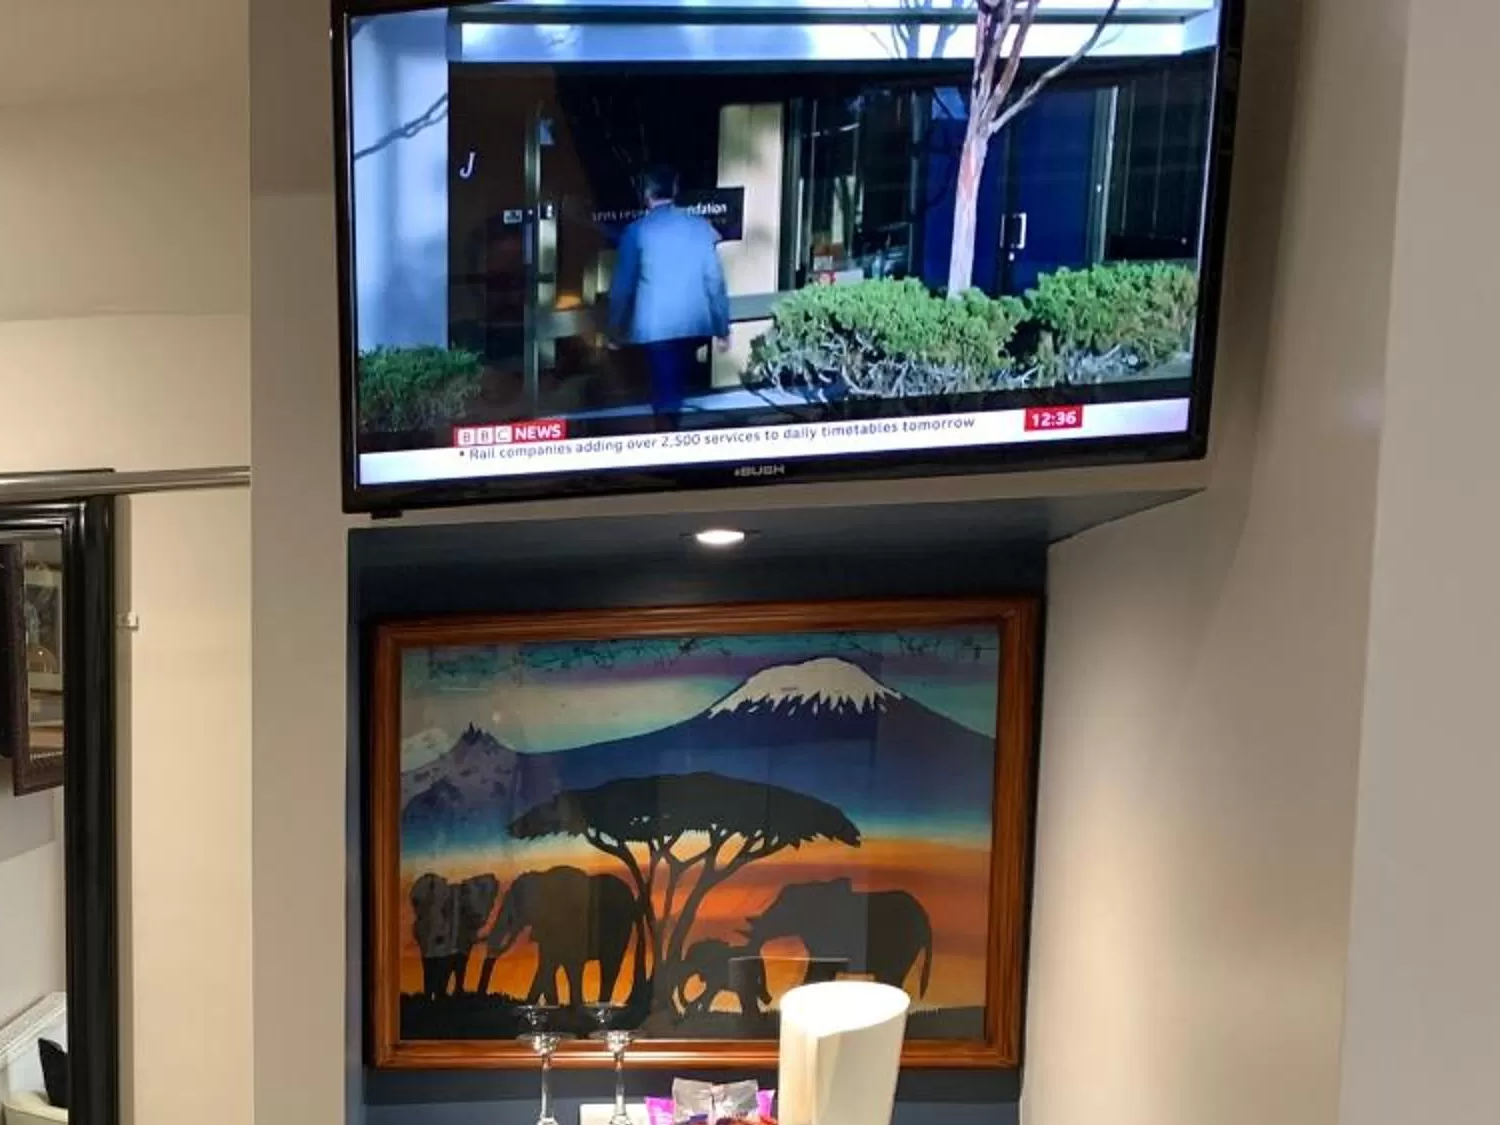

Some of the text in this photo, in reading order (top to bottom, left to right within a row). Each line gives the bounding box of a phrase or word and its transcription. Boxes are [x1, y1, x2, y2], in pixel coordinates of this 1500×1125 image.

[1030, 411, 1077, 427] 12:36
[460, 424, 562, 444] BBC NEWS
[469, 417, 976, 460] Rail companies adding over 2,500 services to daily timetables tomorrow
[739, 464, 785, 477] BUSH
